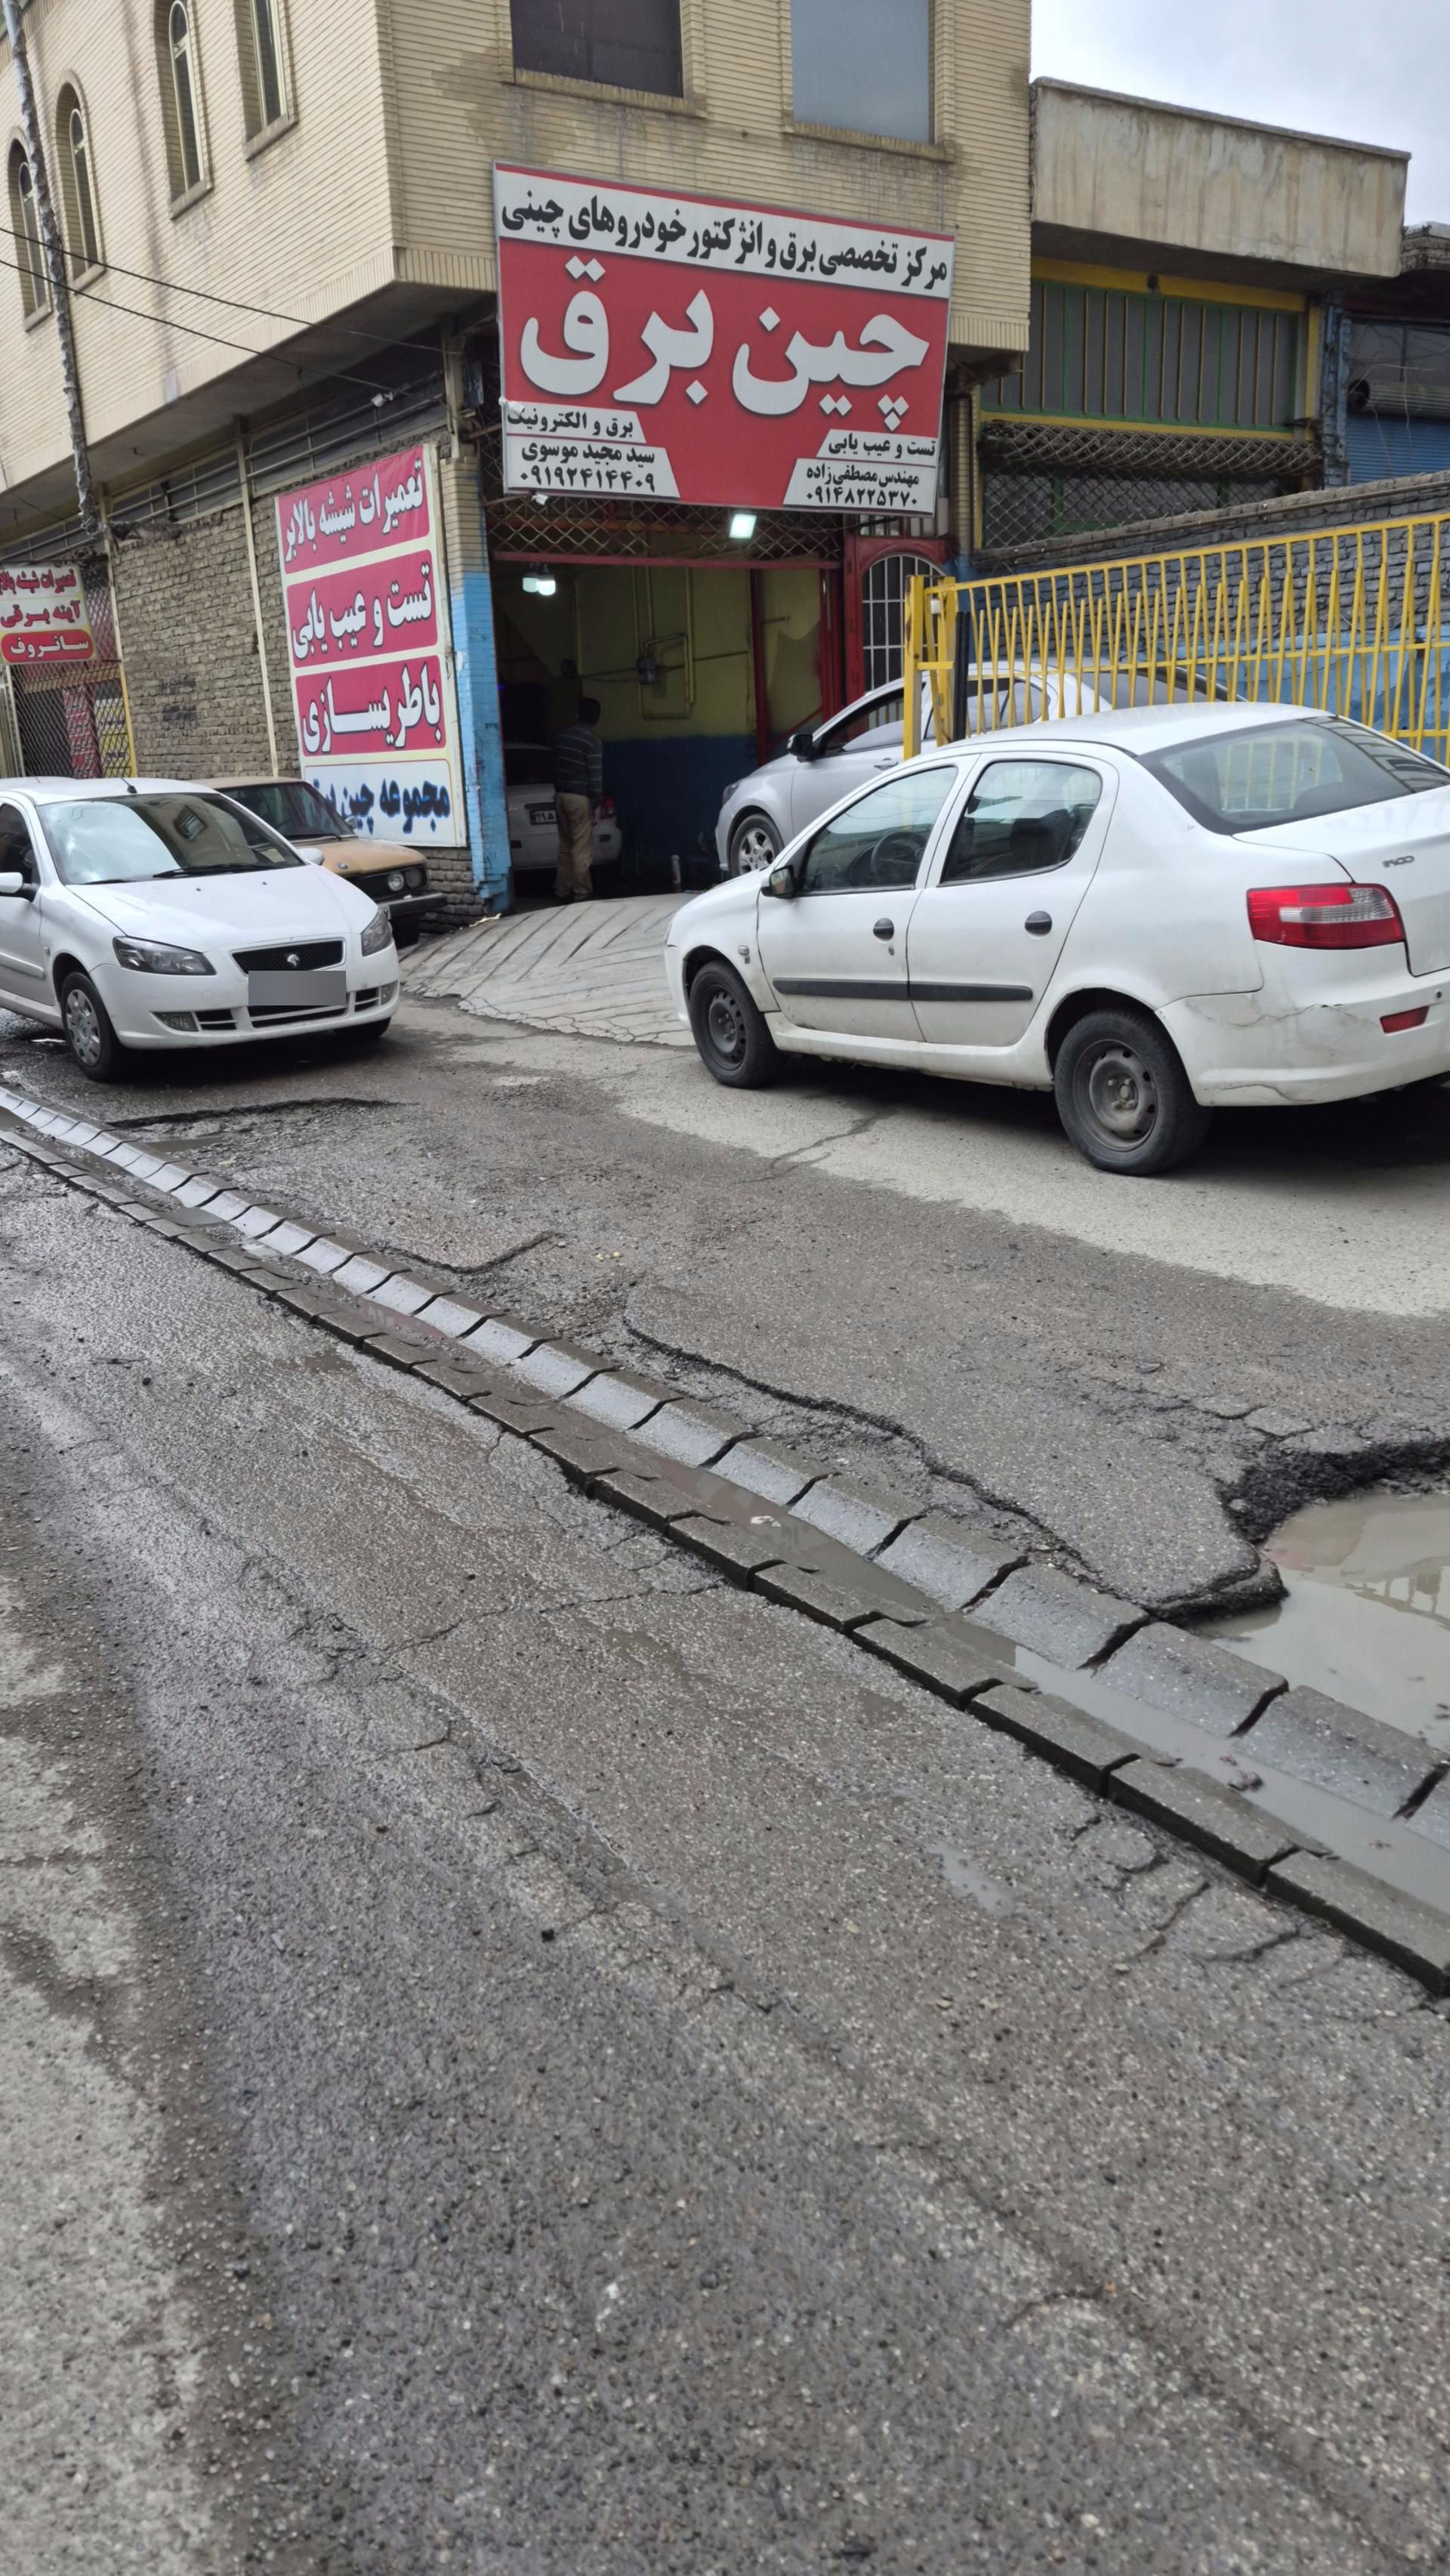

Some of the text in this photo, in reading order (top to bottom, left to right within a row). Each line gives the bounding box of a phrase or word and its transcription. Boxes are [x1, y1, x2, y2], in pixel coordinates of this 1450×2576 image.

[502, 190, 947, 290] مرکز تخصصی برق و انژکتور خودروهای چینی
[520, 255, 930, 431] چین برق
[592, 420, 601, 436] و
[606, 418, 634, 438] برق
[521, 442, 655, 468] سید مجید موسوی
[828, 432, 936, 459] تست و عیب یابی
[520, 464, 656, 493] ۰۹۱۹۲۴۱۴۴۰۹
[878, 471, 920, 488] مهندس
[807, 485, 918, 508] ۰۹۱۴۸۲۲۵۳۷۰
[285, 458, 424, 562] تعمیرات شیشه بالابر
[1, 604, 51, 629] برقی
[292, 562, 432, 660] تست و عیب یابی
[10, 635, 89, 658] سانروف
[379, 777, 451, 834] مجموعه
